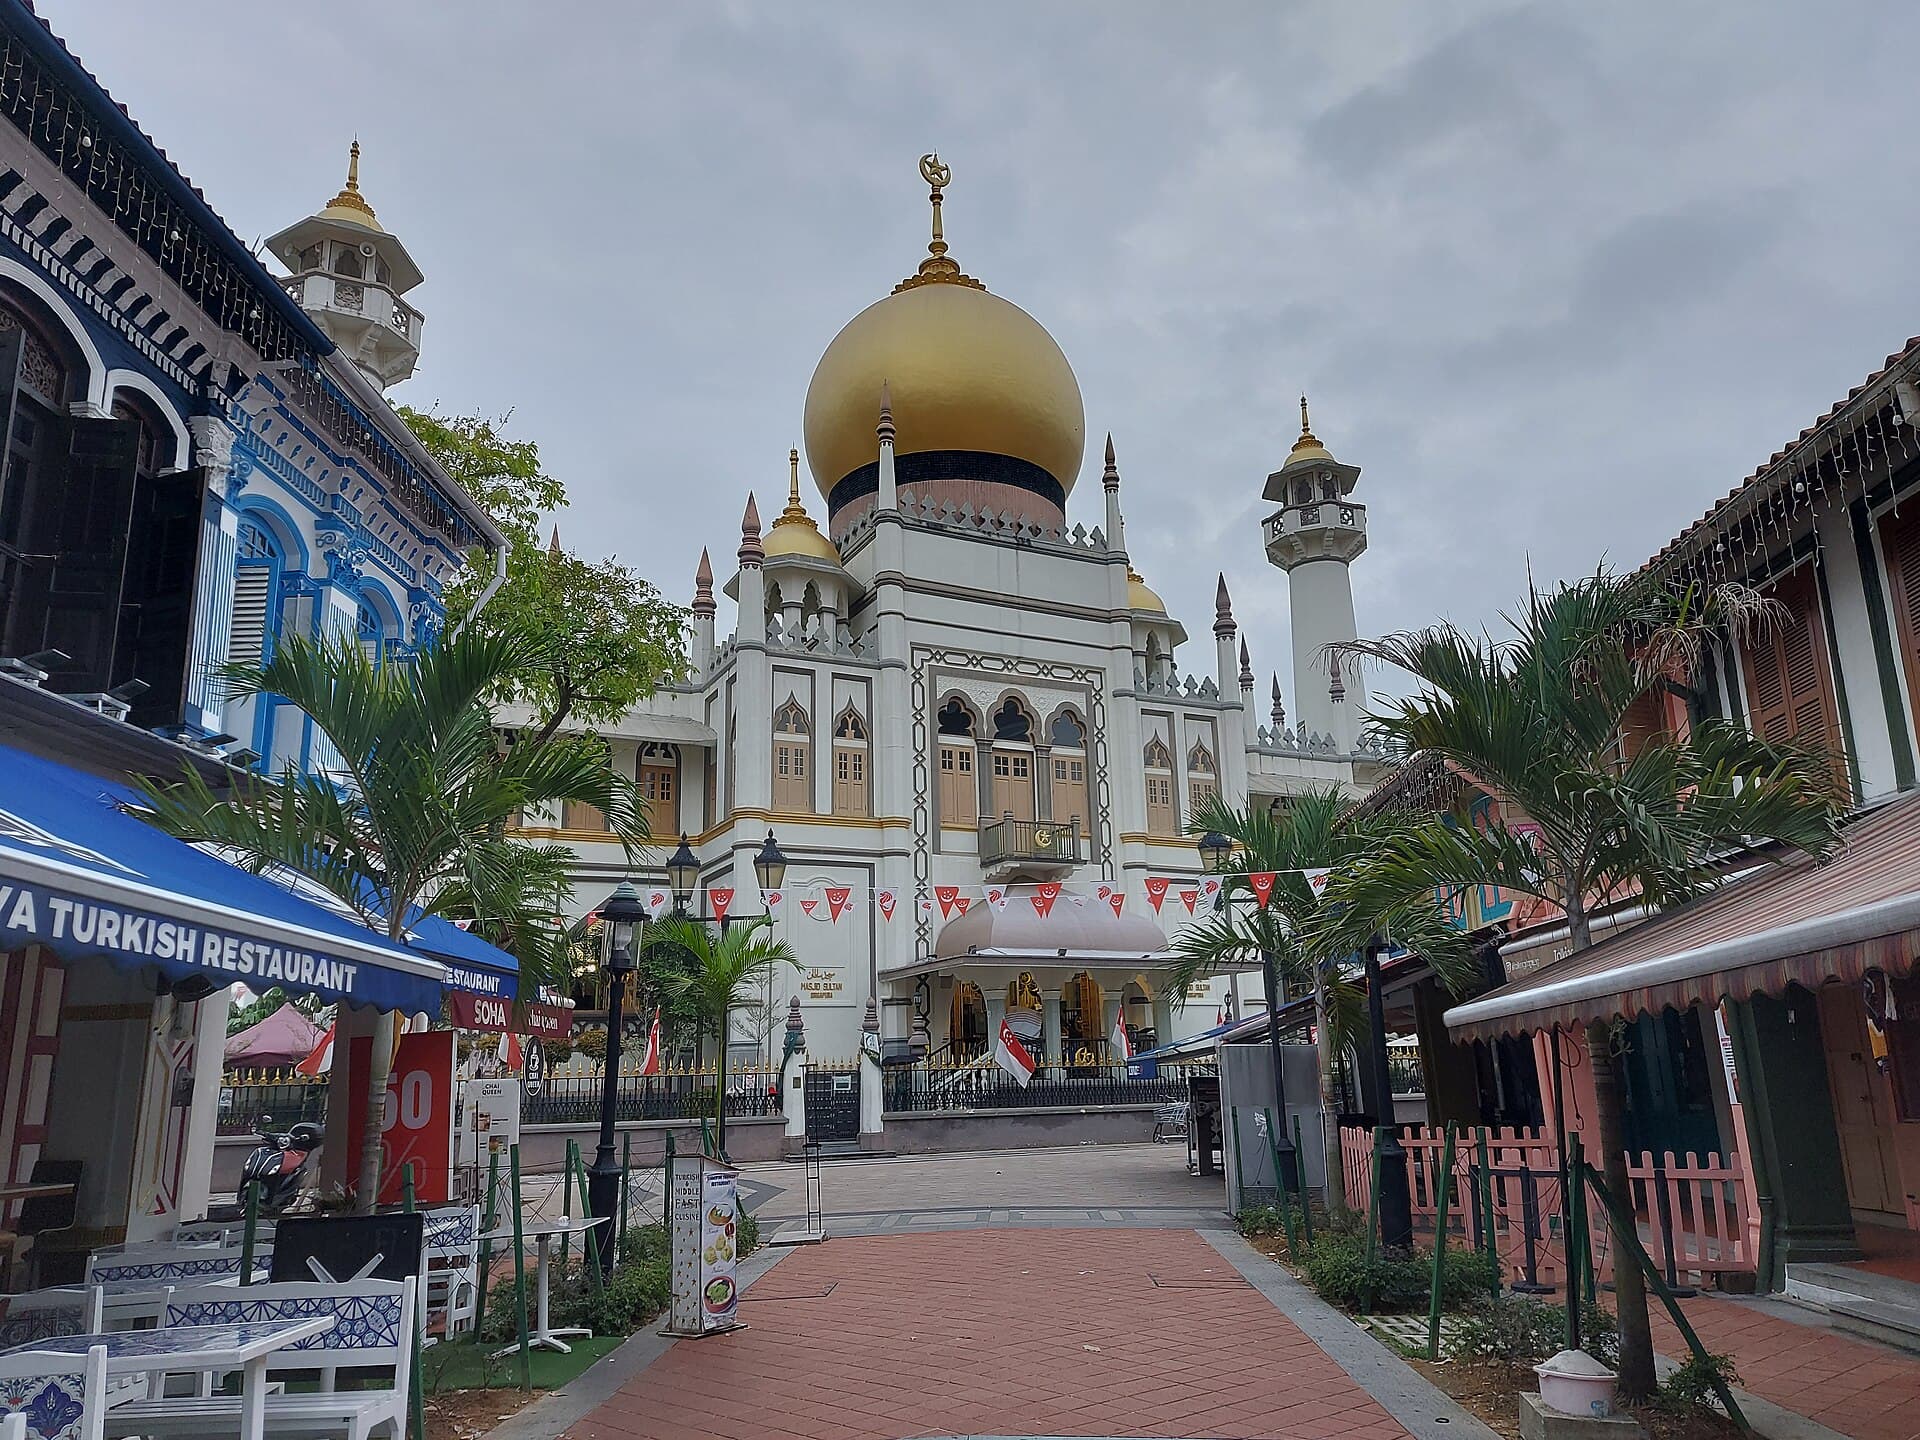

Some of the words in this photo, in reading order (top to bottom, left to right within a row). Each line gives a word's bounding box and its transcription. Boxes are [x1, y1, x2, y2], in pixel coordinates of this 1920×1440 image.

[49, 897, 196, 963] TURKISH
[201, 932, 357, 993] RESTAURANT
[474, 1000, 507, 1026] SOHA
[675, 1187, 700, 1195] MIDDLE
[675, 1199, 700, 1209] EAST
[675, 1213, 700, 1221] CUISINE
